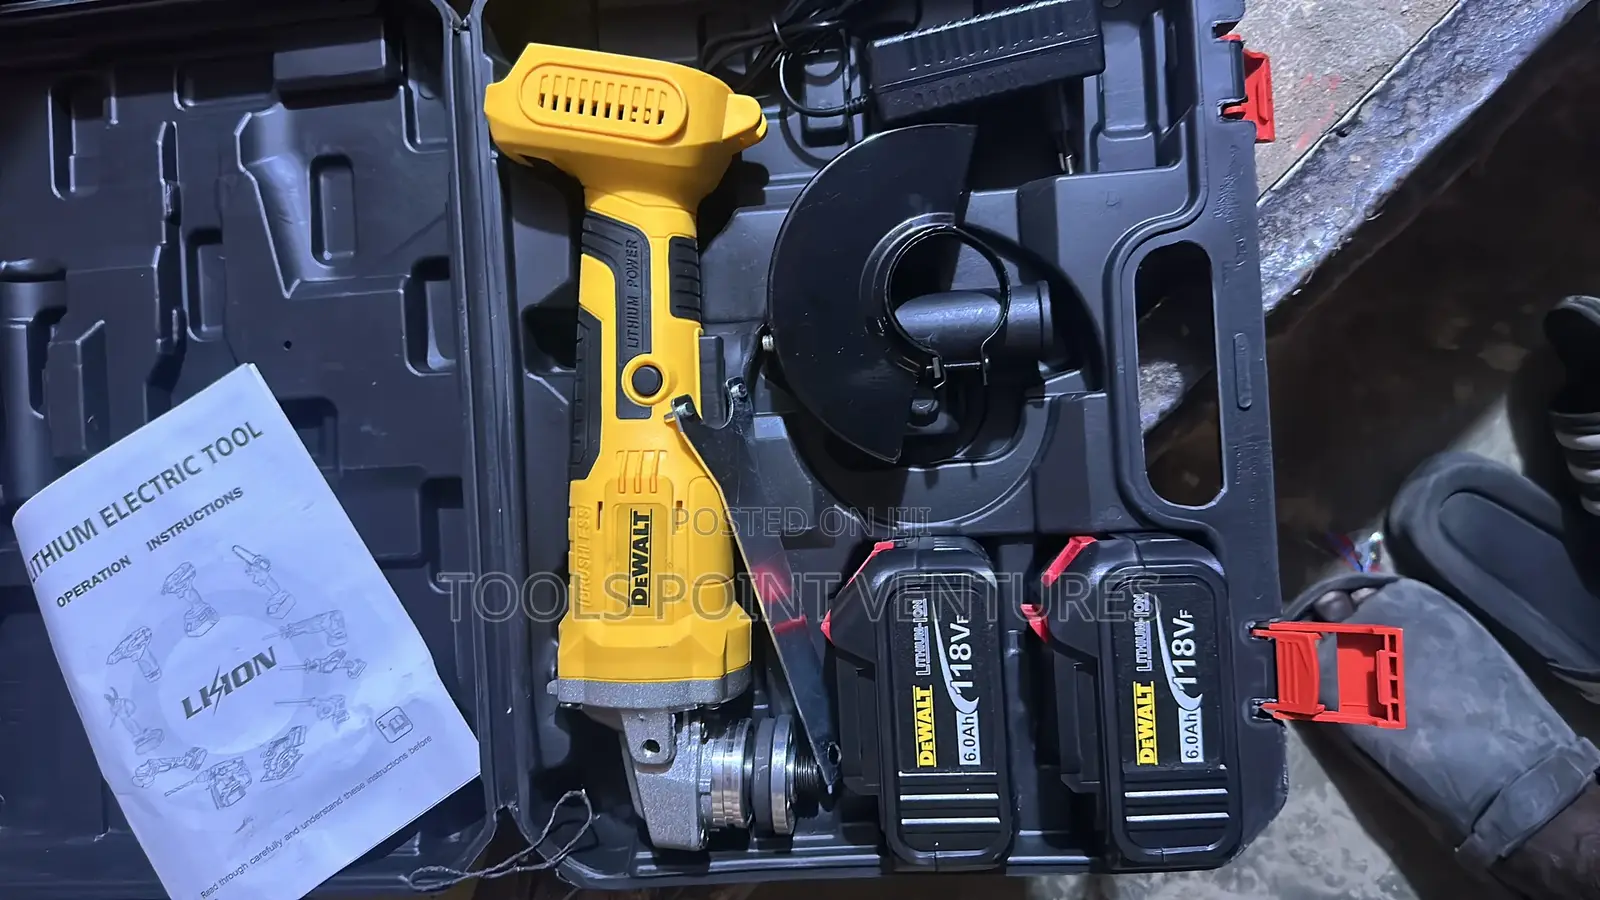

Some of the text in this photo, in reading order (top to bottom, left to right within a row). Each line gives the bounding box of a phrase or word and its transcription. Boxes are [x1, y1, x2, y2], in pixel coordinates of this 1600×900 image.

[625, 239, 640, 348] LITHIUM POWER
[28, 421, 264, 582] LITHIUM ELECTRIC TOOL
[56, 487, 244, 607] OPERATION INSTRUCTIONS
[630, 511, 650, 606] DEWALT
[912, 598, 935, 767] DEWALT LITHIUM-ION
[1133, 592, 1156, 764] DEWALT LITHIUM-ION
[1184, 710, 1199, 759] 6.0Ah
[962, 716, 977, 762] 6.0Ah
[200, 735, 433, 899] Read through carefully and understand these instructions before
